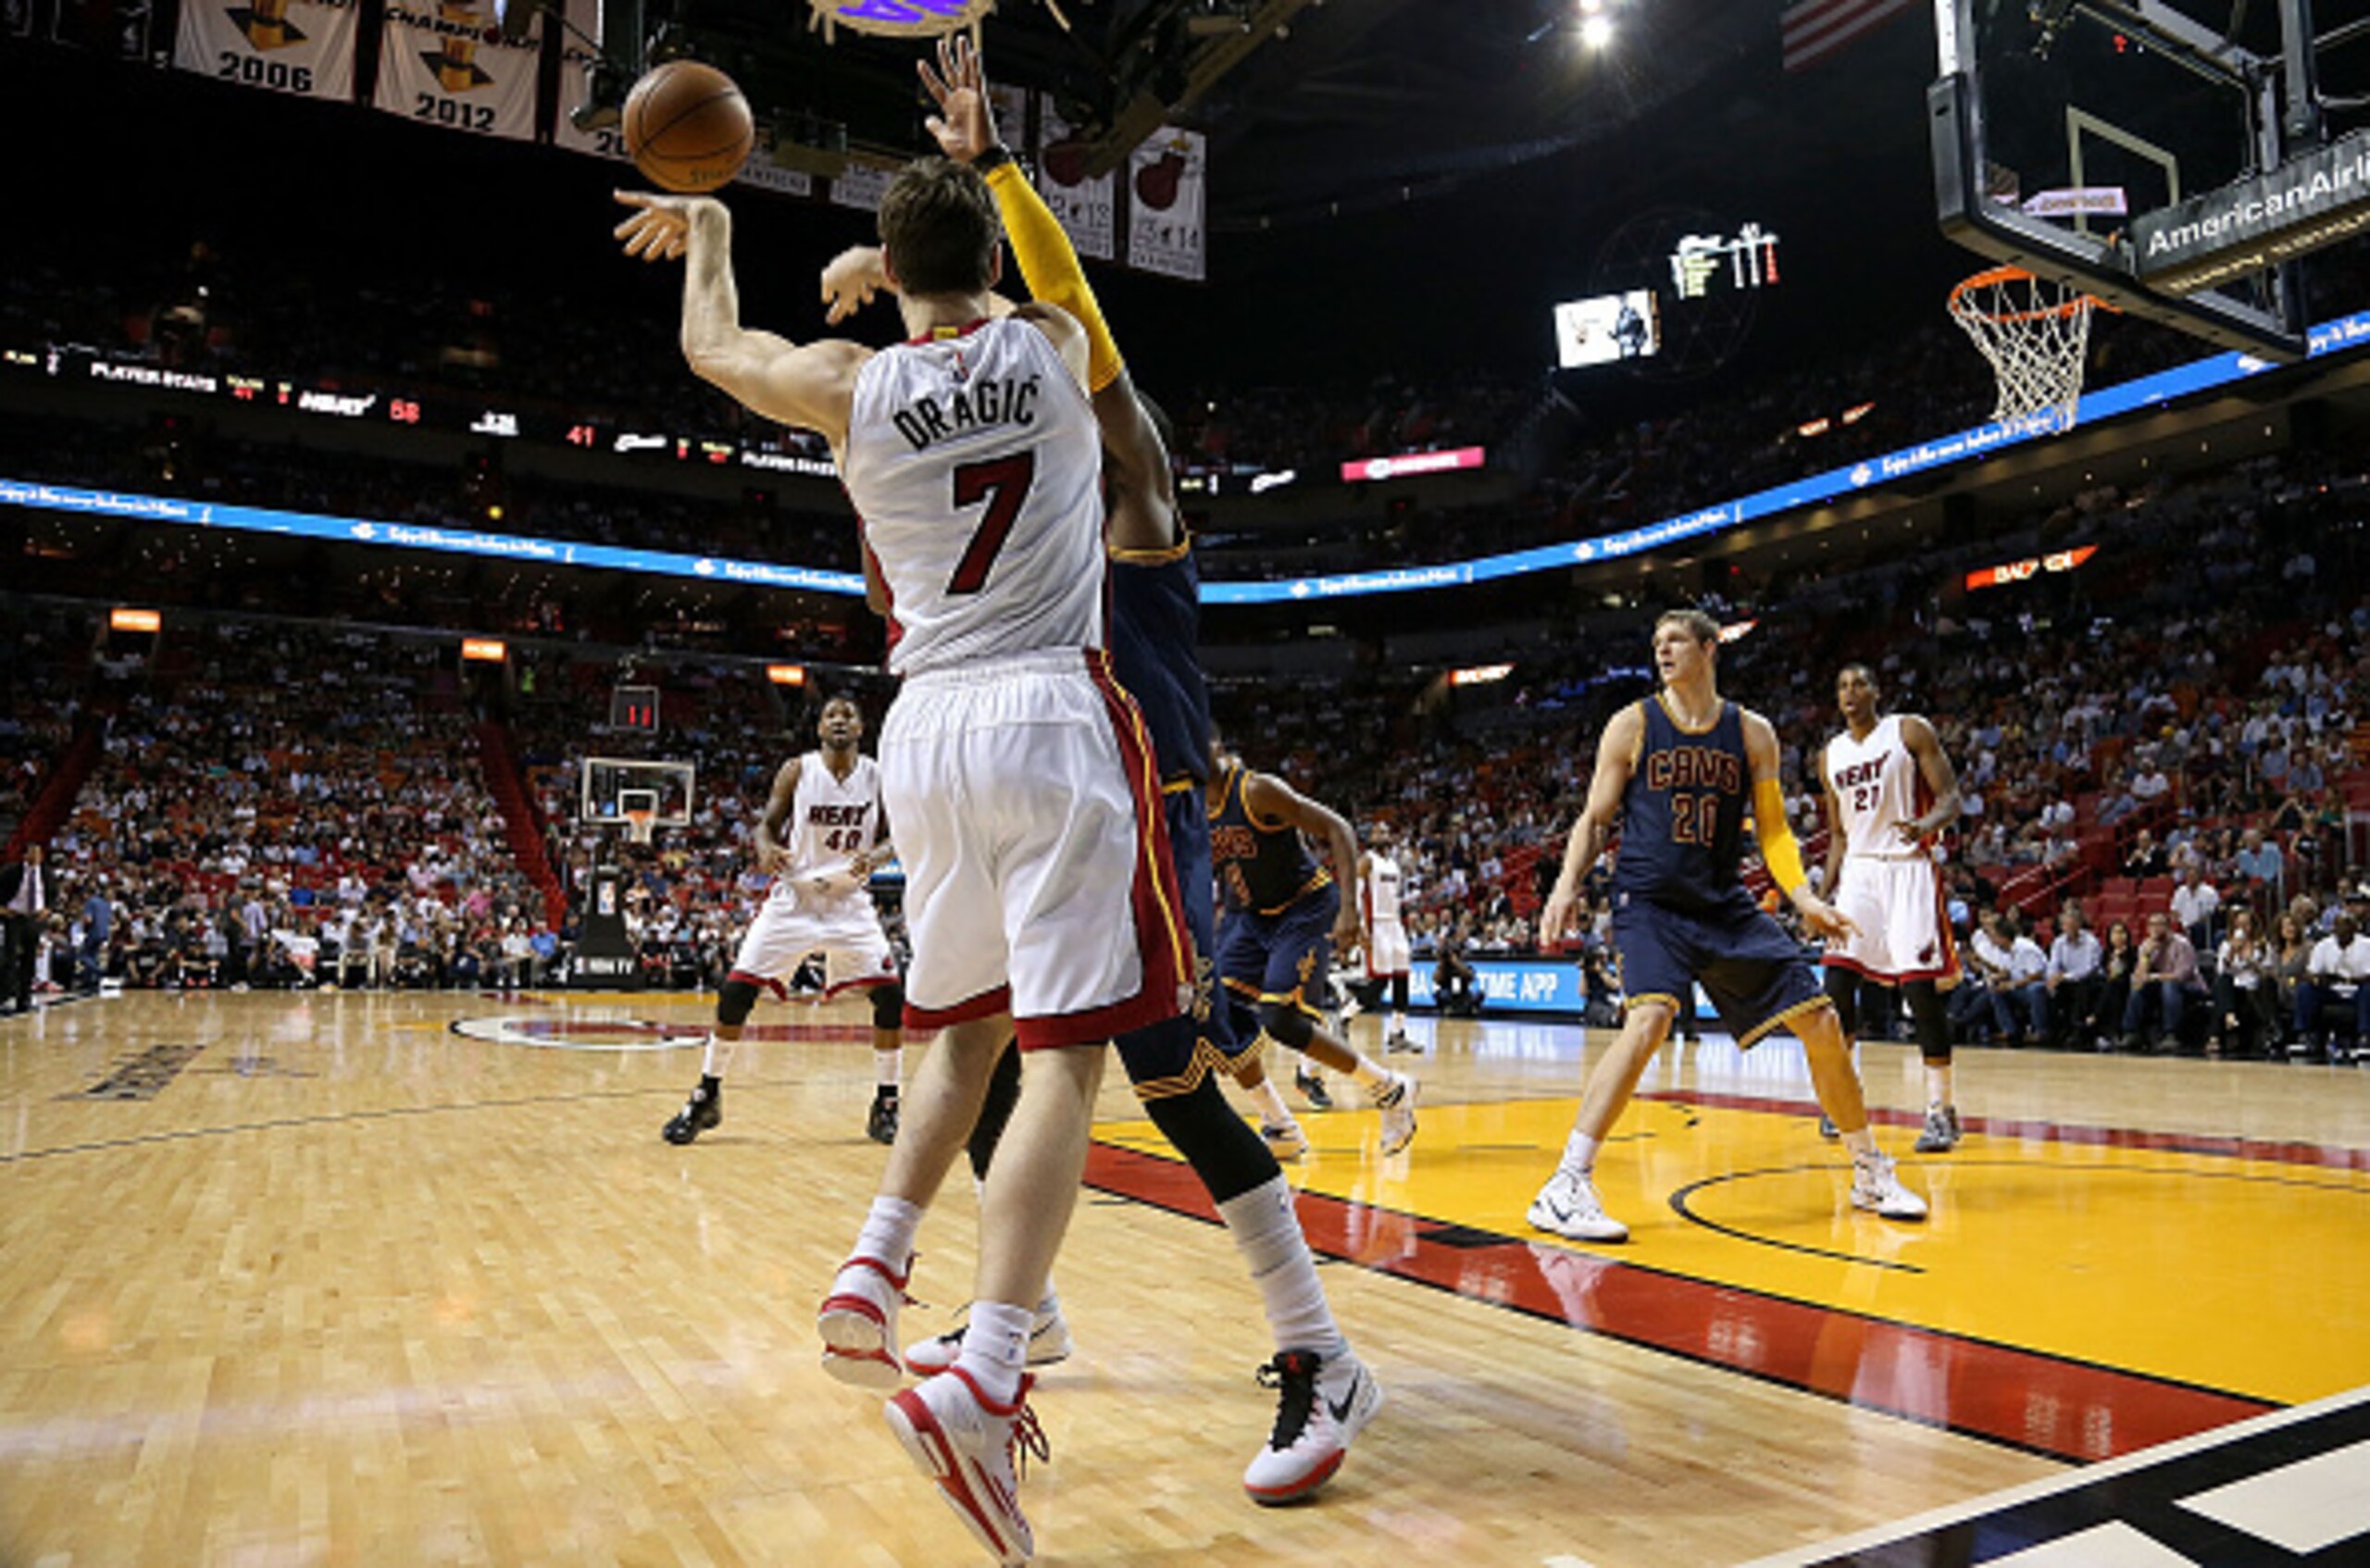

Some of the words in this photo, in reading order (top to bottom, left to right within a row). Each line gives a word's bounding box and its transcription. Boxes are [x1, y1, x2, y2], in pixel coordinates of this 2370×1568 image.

[218, 51, 313, 92] 2006
[414, 93, 496, 132] 2012
[944, 449, 1037, 596] 7
[1647, 745, 1742, 795] CAVS
[1834, 750, 1892, 790] HEAT
[807, 802, 872, 828] HEAT
[1671, 793, 1720, 847] 20
[825, 830, 863, 852] 40
[1520, 972, 1559, 1002] APP
